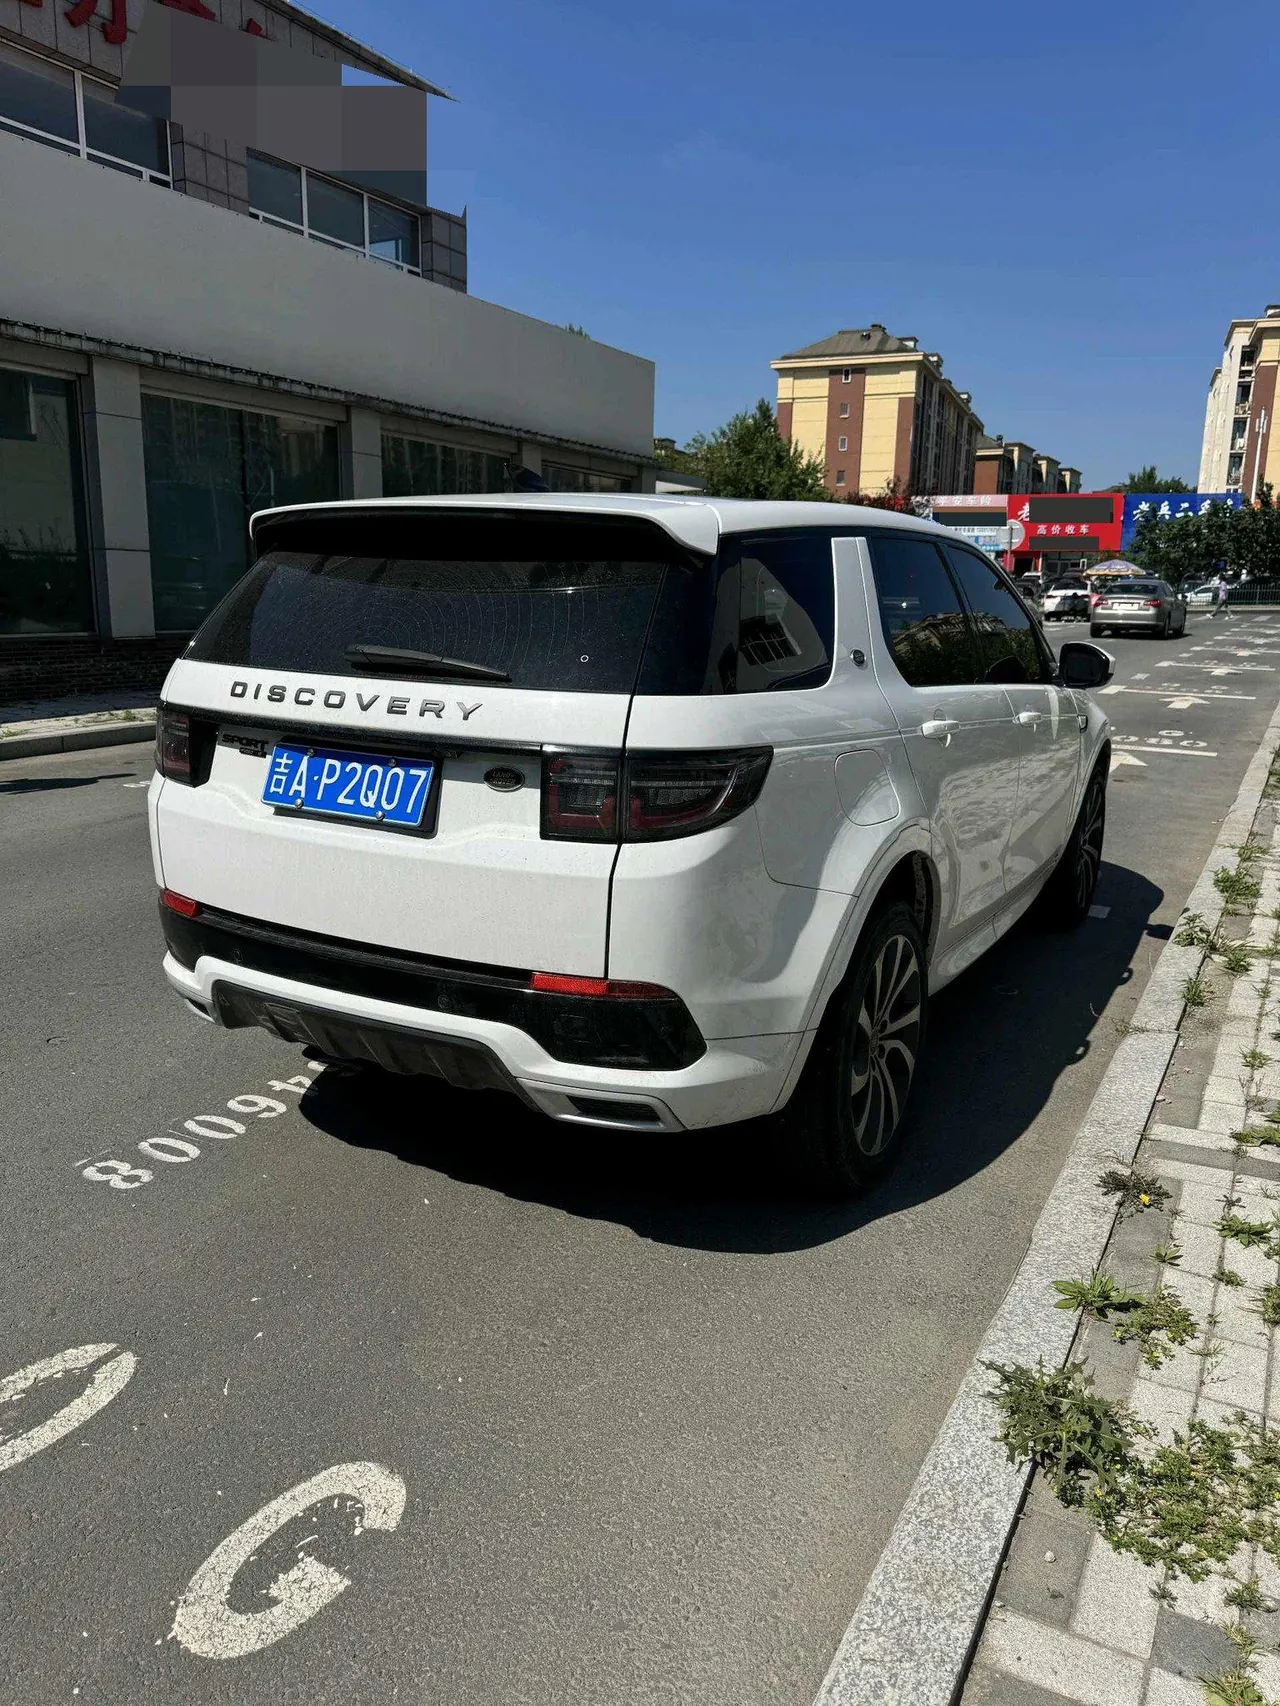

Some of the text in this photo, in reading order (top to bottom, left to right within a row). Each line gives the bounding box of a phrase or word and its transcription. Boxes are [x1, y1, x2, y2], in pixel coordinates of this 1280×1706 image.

[1132, 498, 1234, 520] 老兵二手
[1036, 524, 1089, 534] 高价收车
[230, 681, 483, 721] DISCOVERY
[222, 734, 269, 751] SPORT
